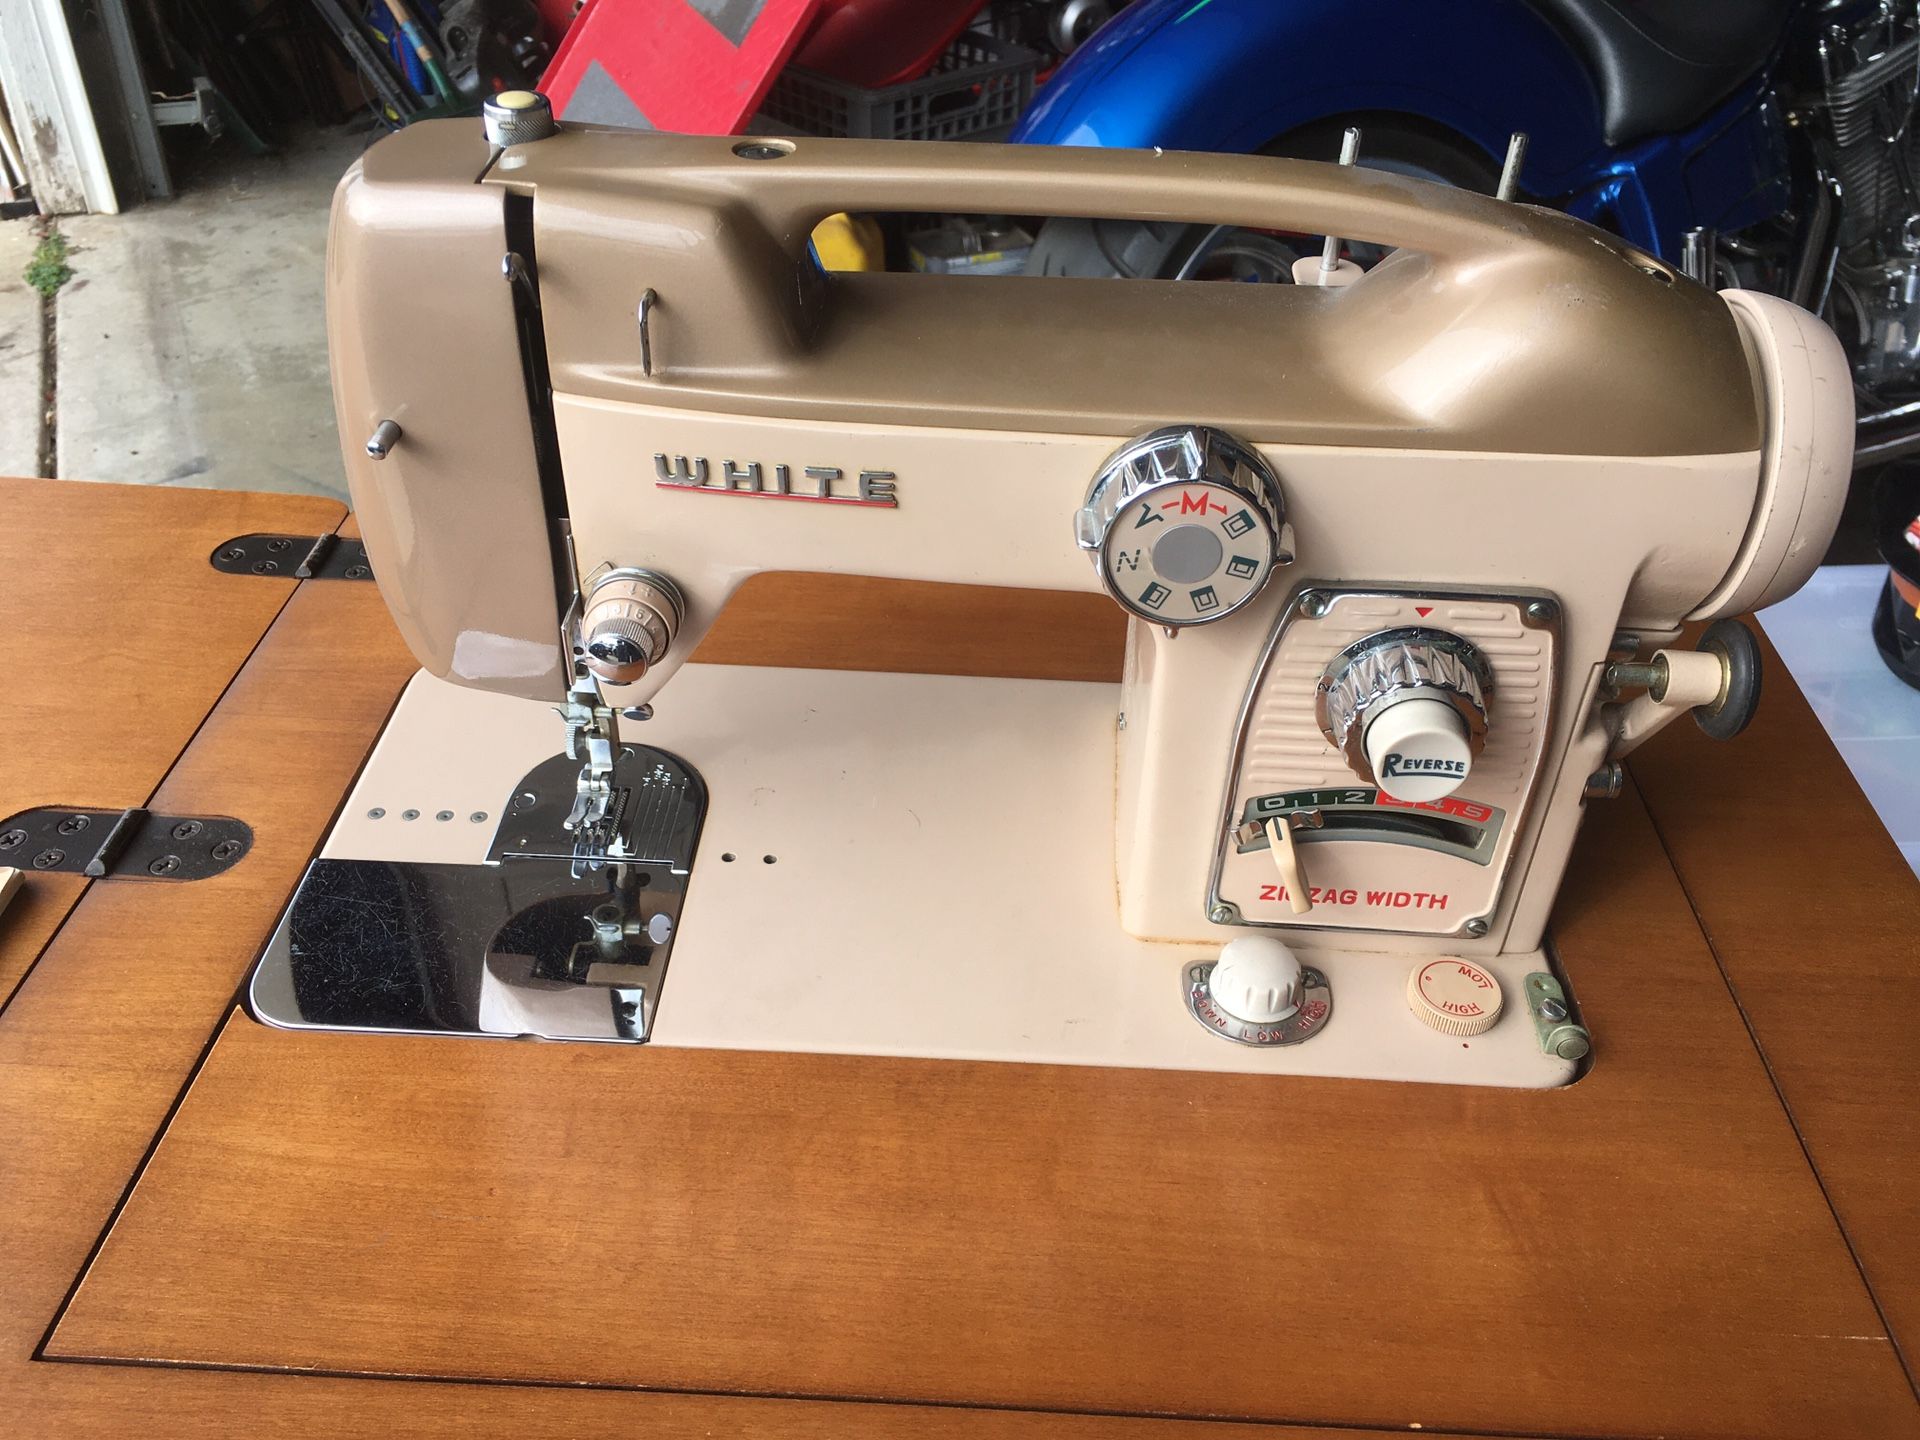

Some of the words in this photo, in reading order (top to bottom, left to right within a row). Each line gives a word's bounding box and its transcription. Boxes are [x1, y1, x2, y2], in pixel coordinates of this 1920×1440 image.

[654, 453, 896, 501] WHITE
[1382, 753, 1465, 778] REVERSE
[1312, 793, 1318, 804] 1
[1344, 791, 1366, 802] 2
[1463, 805, 1484, 818] 5
[1366, 891, 1448, 910] WIDTH
[1458, 966, 1489, 988] LOW
[1442, 1001, 1480, 1014] HIGH
[1244, 1030, 1284, 1041] LOW
